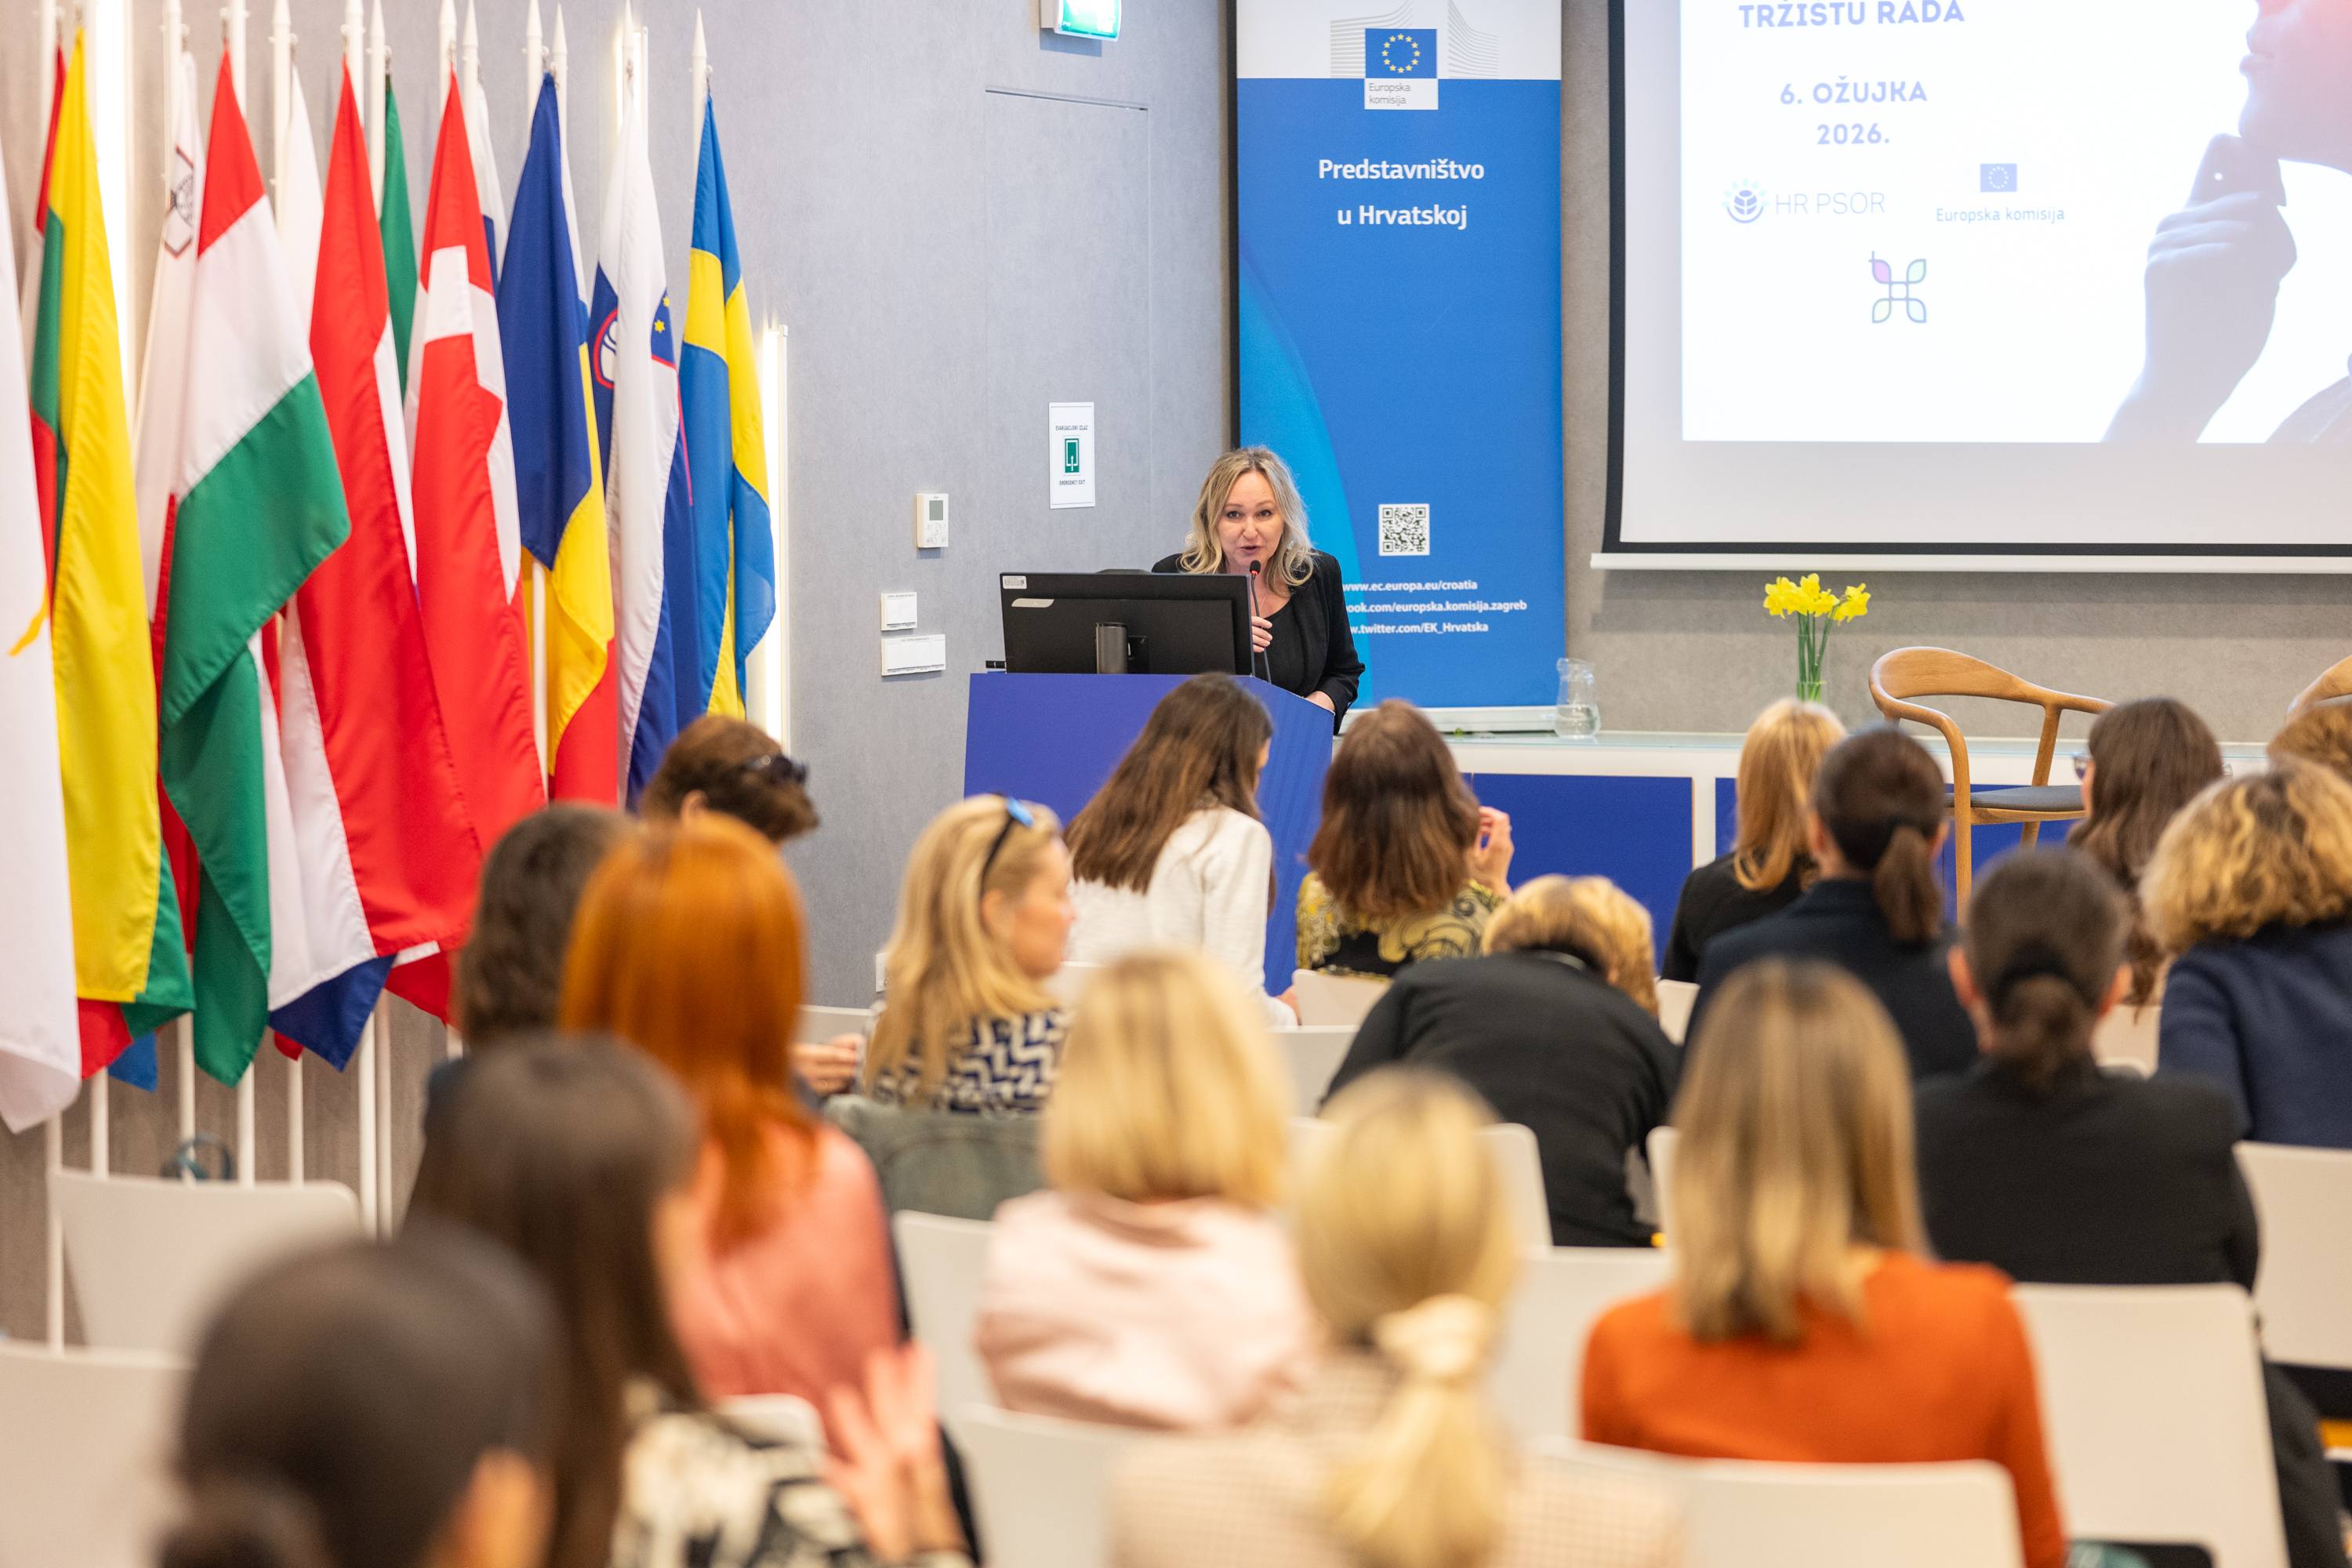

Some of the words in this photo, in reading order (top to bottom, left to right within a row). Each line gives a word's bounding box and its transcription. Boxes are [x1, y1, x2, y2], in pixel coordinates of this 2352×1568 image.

[1877, 0, 1965, 24] RADA
[1369, 82, 1410, 93] Europska
[1780, 83, 1803, 105] 6.
[1813, 75, 1928, 104] OŽUJKA
[1369, 95, 1406, 107] komisija
[1817, 123, 1890, 145] 2026.
[1319, 158, 1485, 180] Predstavništvo
[1775, 193, 1809, 214] HR
[1816, 192, 1886, 214] PSOR
[1338, 209, 1352, 225] u
[1359, 205, 1468, 230] Hrvatskoj
[1936, 208, 2001, 224] Europska
[2005, 208, 2065, 224] komisija
[1346, 600, 1528, 614] ook.com/europska.komisija.zagreb
[1350, 622, 1489, 634] w.twitter.com/EK_Hrvatska
